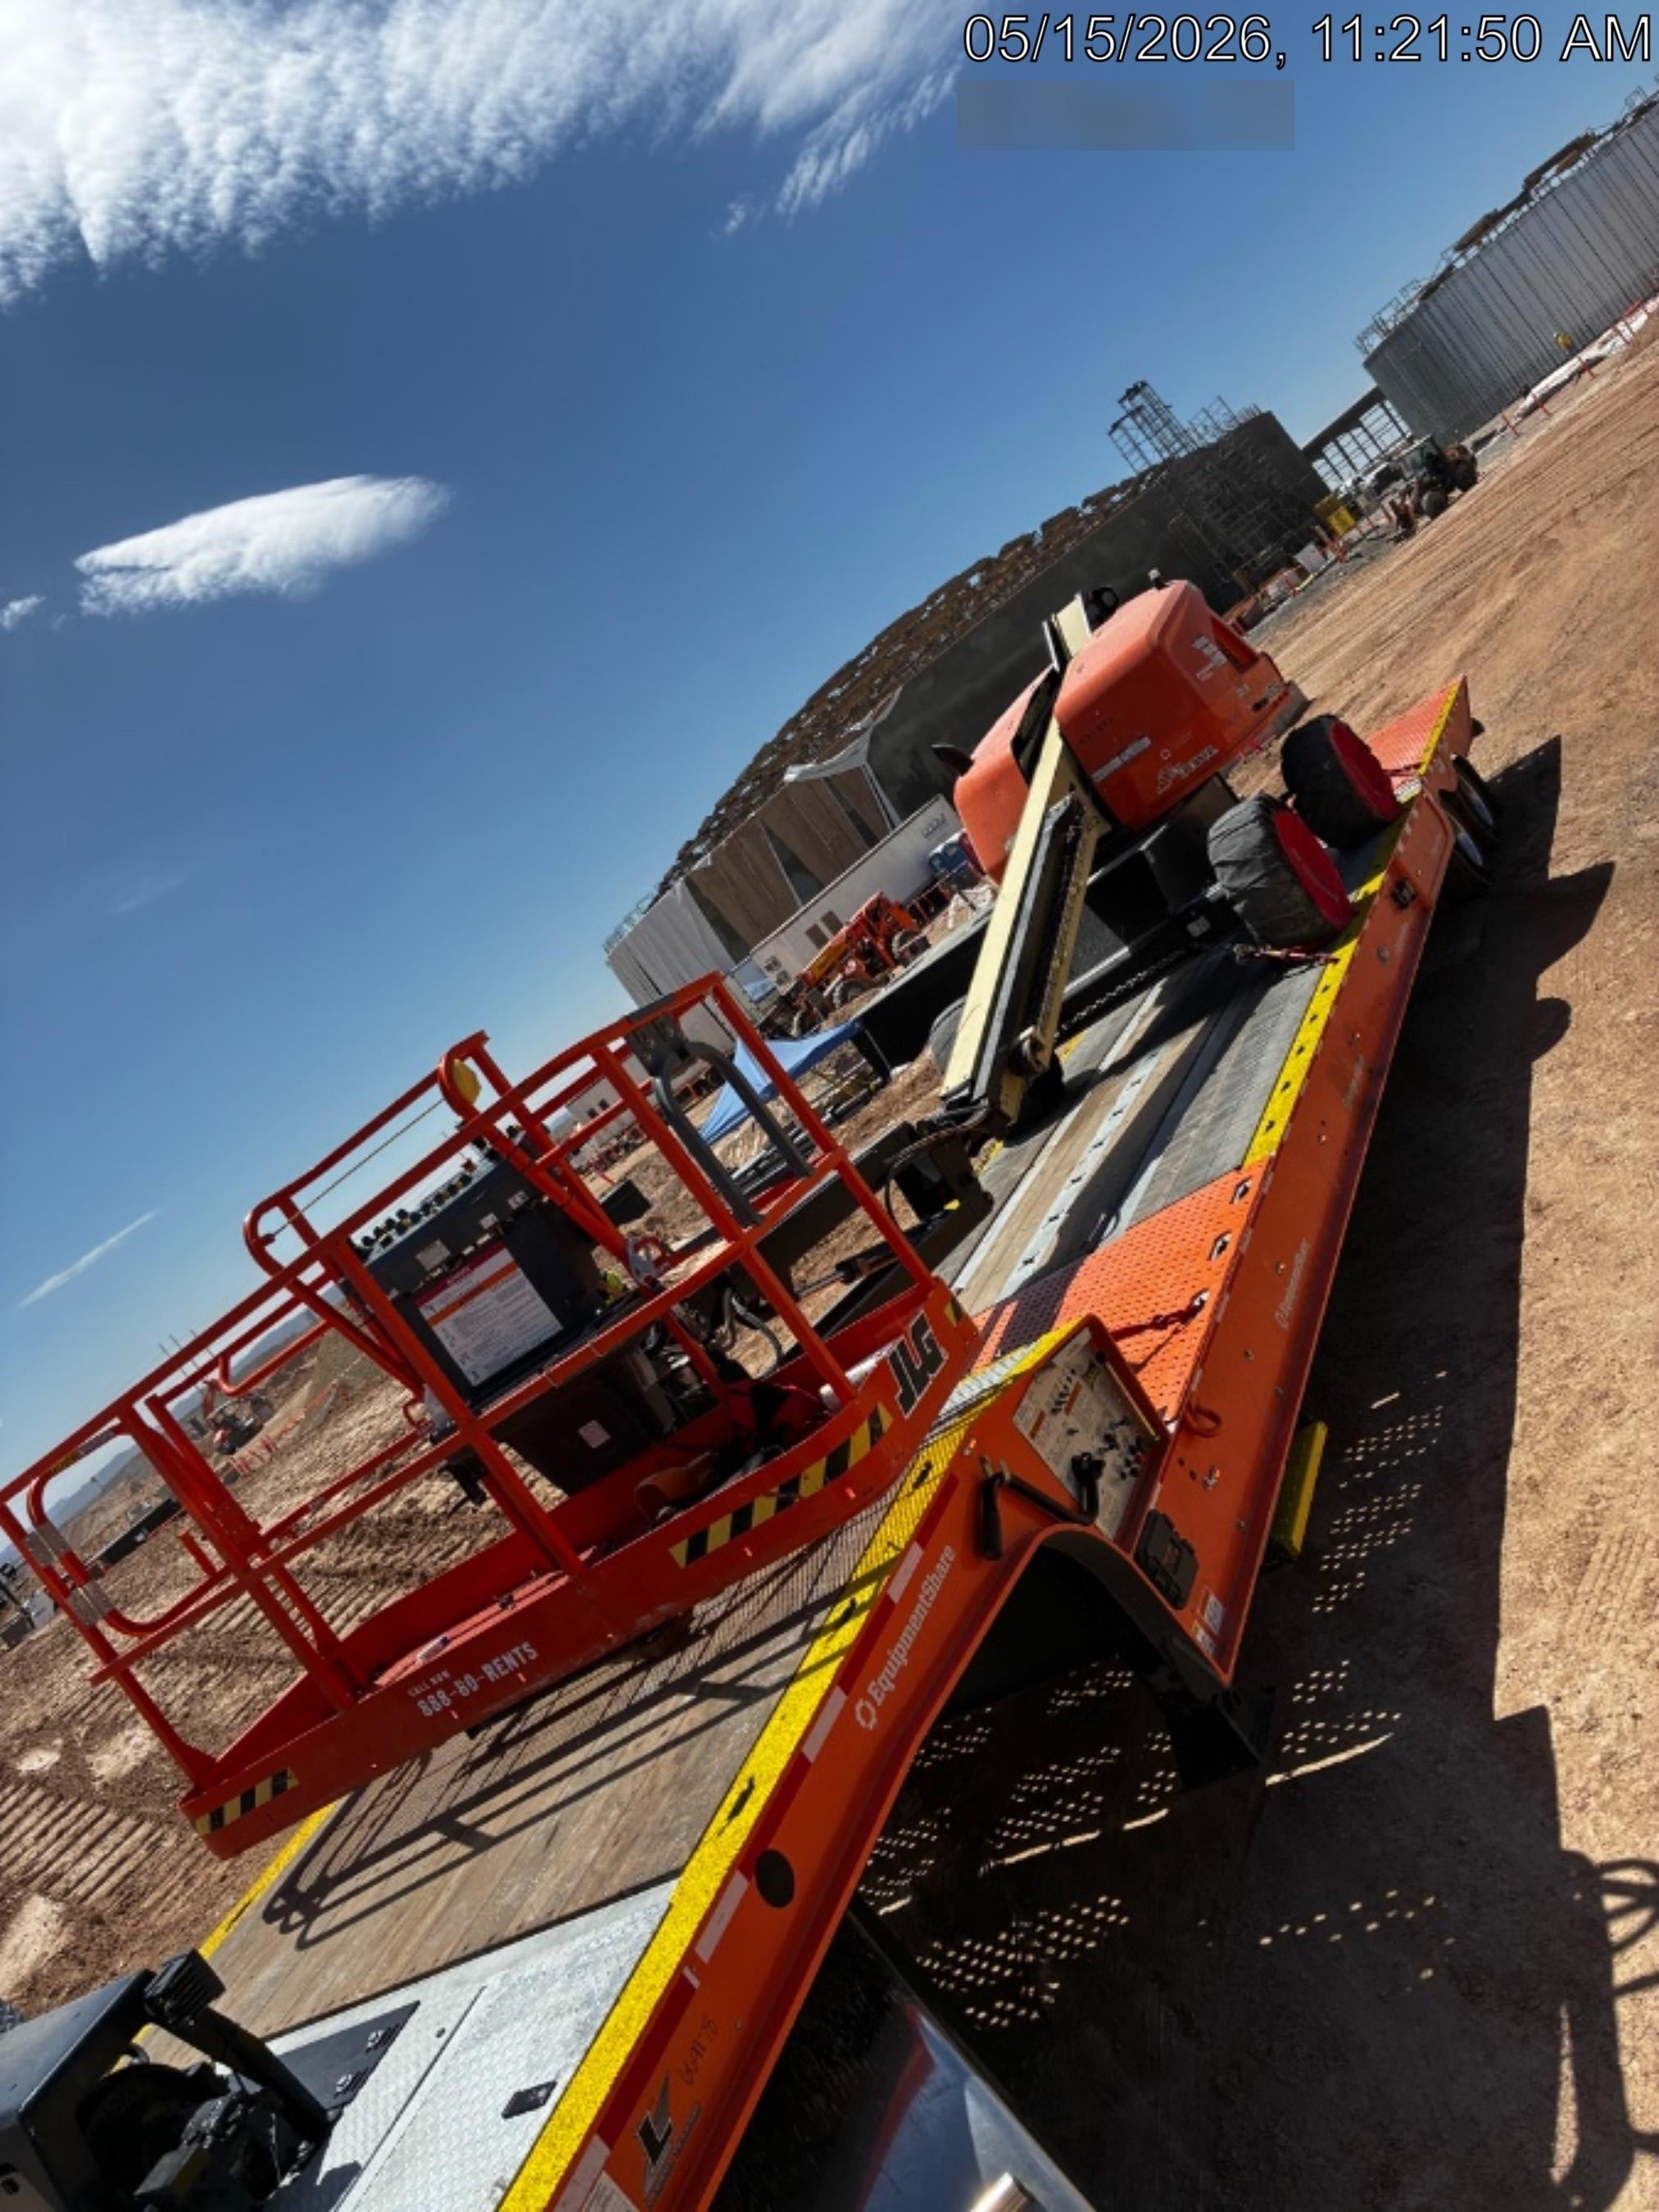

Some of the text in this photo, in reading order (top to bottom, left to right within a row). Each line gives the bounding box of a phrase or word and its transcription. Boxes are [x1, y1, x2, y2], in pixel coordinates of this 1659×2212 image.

[886, 1309, 950, 1420] JLG
[416, 1641, 538, 1716] 888-80-RENTS
[867, 1544, 957, 1707] EquipmentShare
